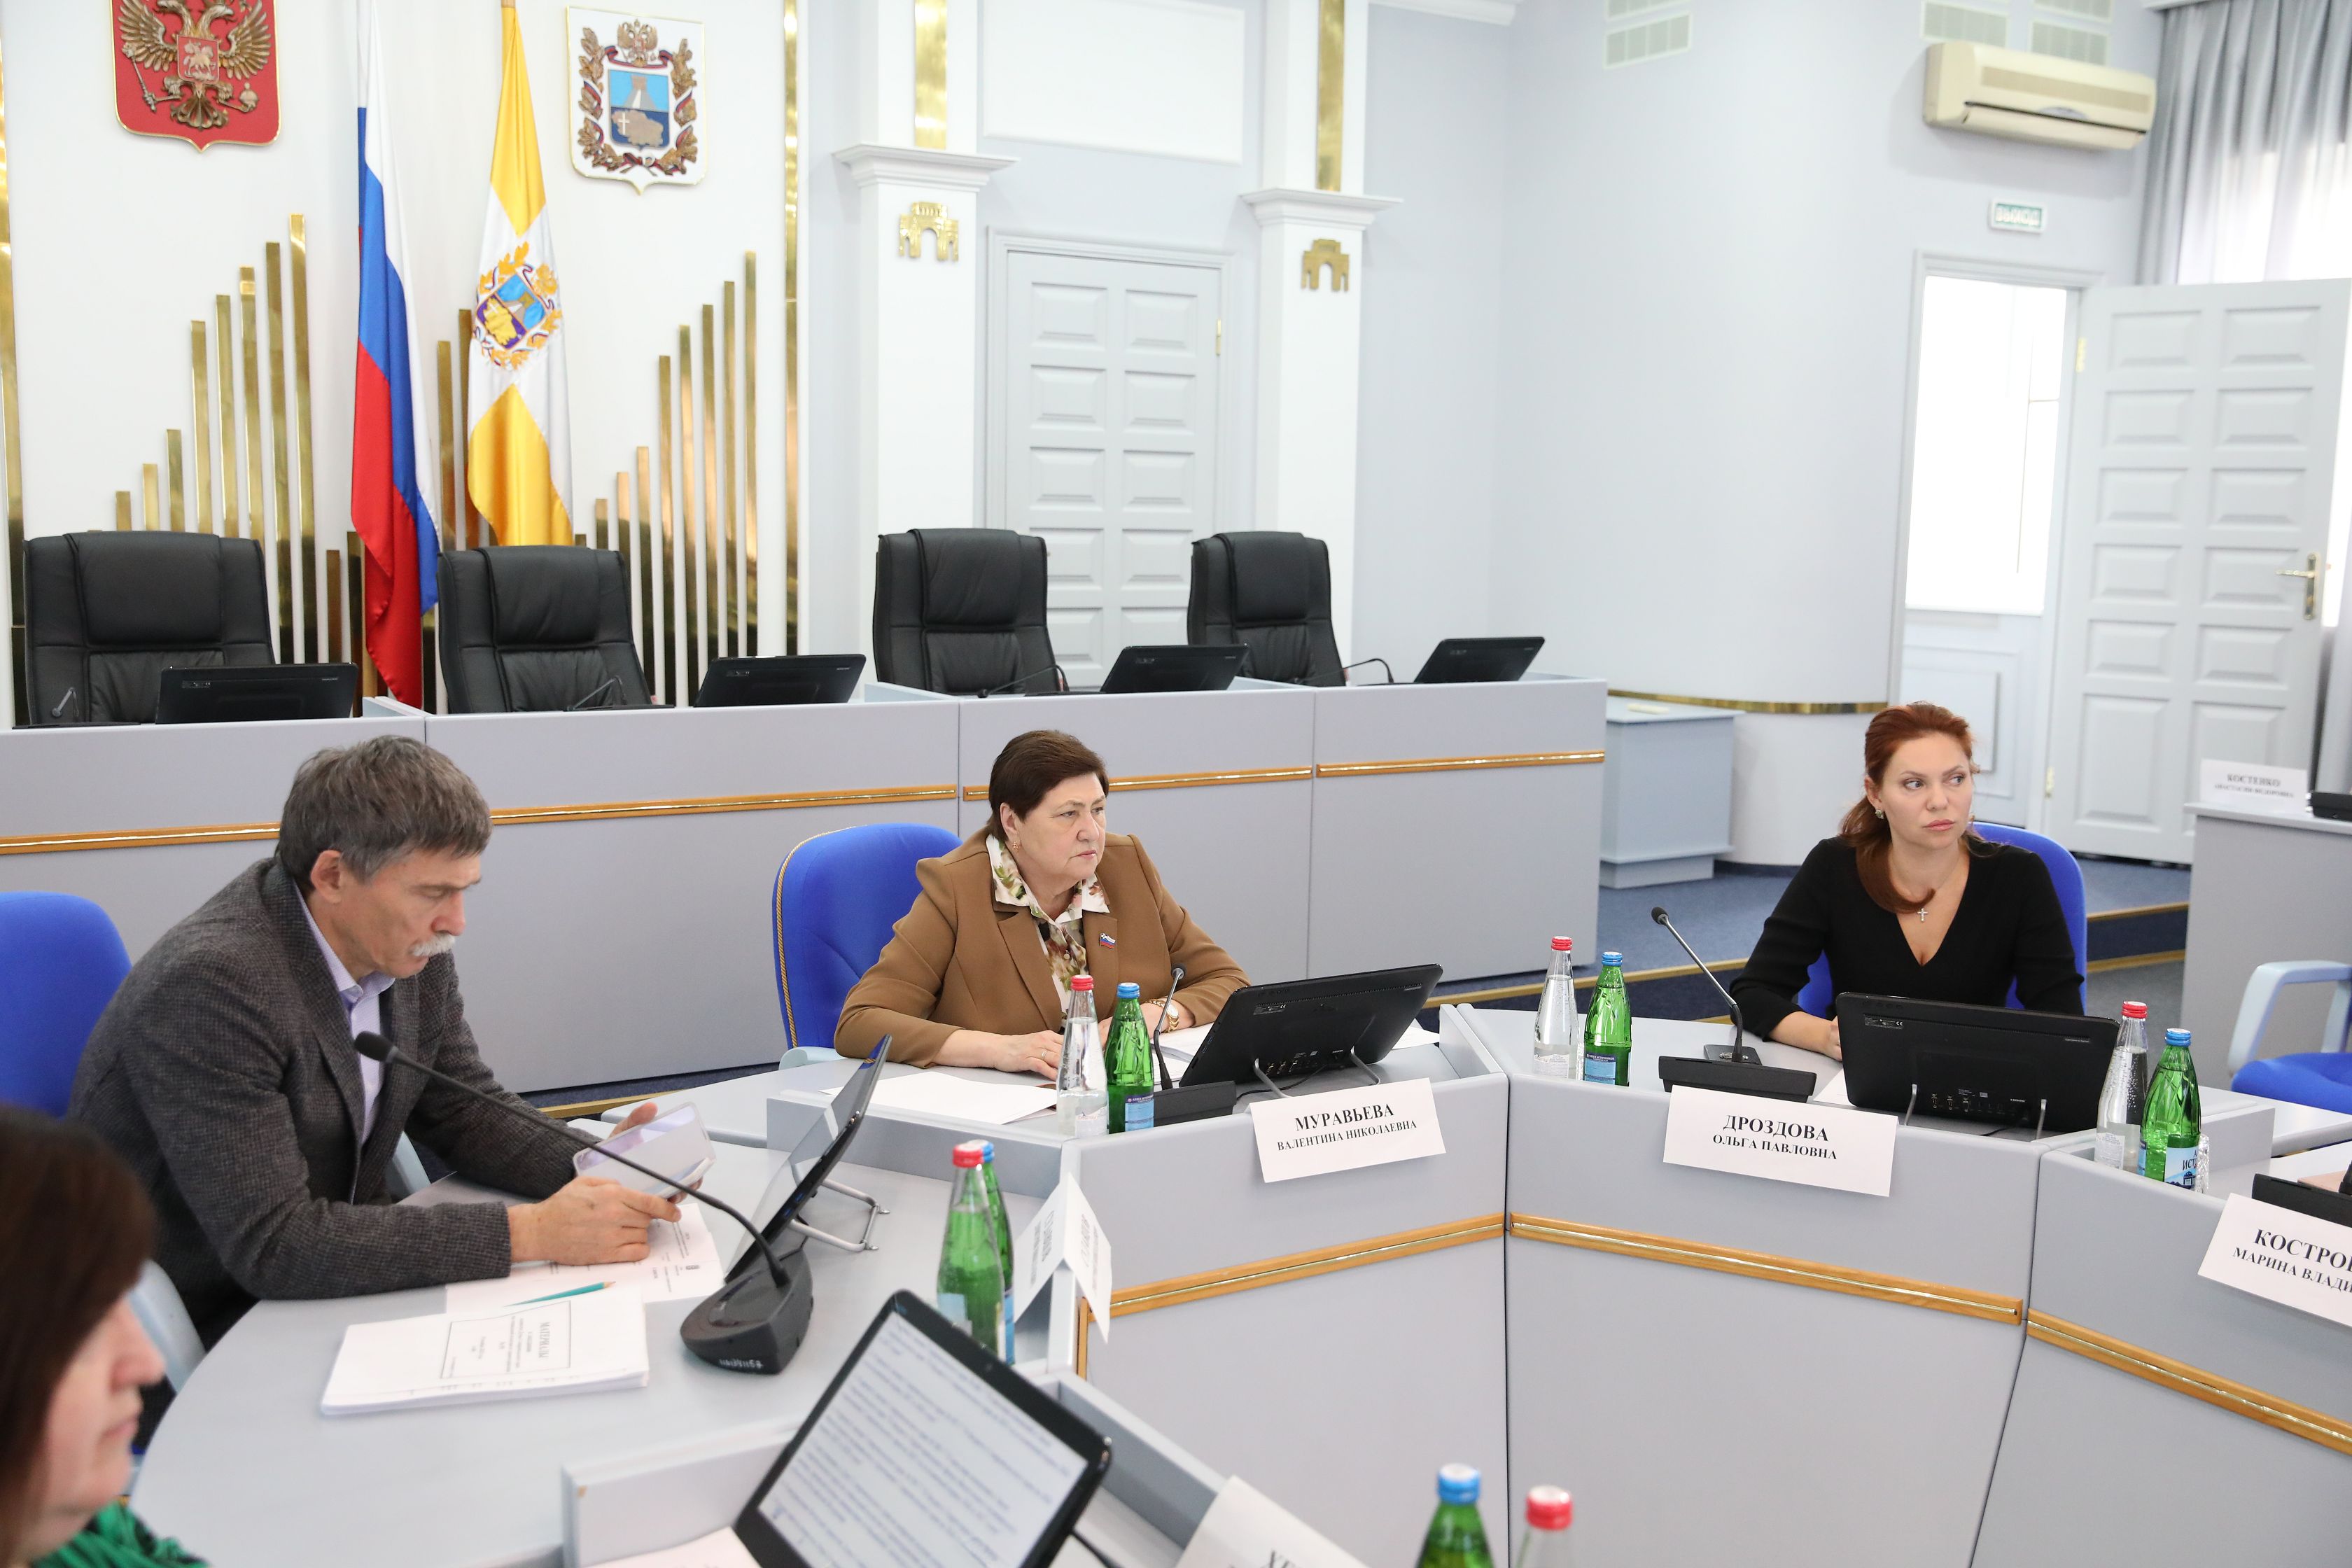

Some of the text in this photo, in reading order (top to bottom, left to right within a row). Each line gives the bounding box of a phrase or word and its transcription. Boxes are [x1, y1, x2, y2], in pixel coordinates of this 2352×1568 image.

[2227, 774, 2281, 787] КОСТЕНКО
[1294, 1103, 1394, 1131] МУРАВЬЕВА
[1723, 1114, 1829, 1142] ДРОЗДОВА
[1277, 1119, 1418, 1151] ВАЛЕНТИНА НИКОЛАЕВНА
[1712, 1133, 1837, 1160] ОЛЬГА ПАВЛОВНА
[2232, 1247, 2297, 1276] МАРИНА
